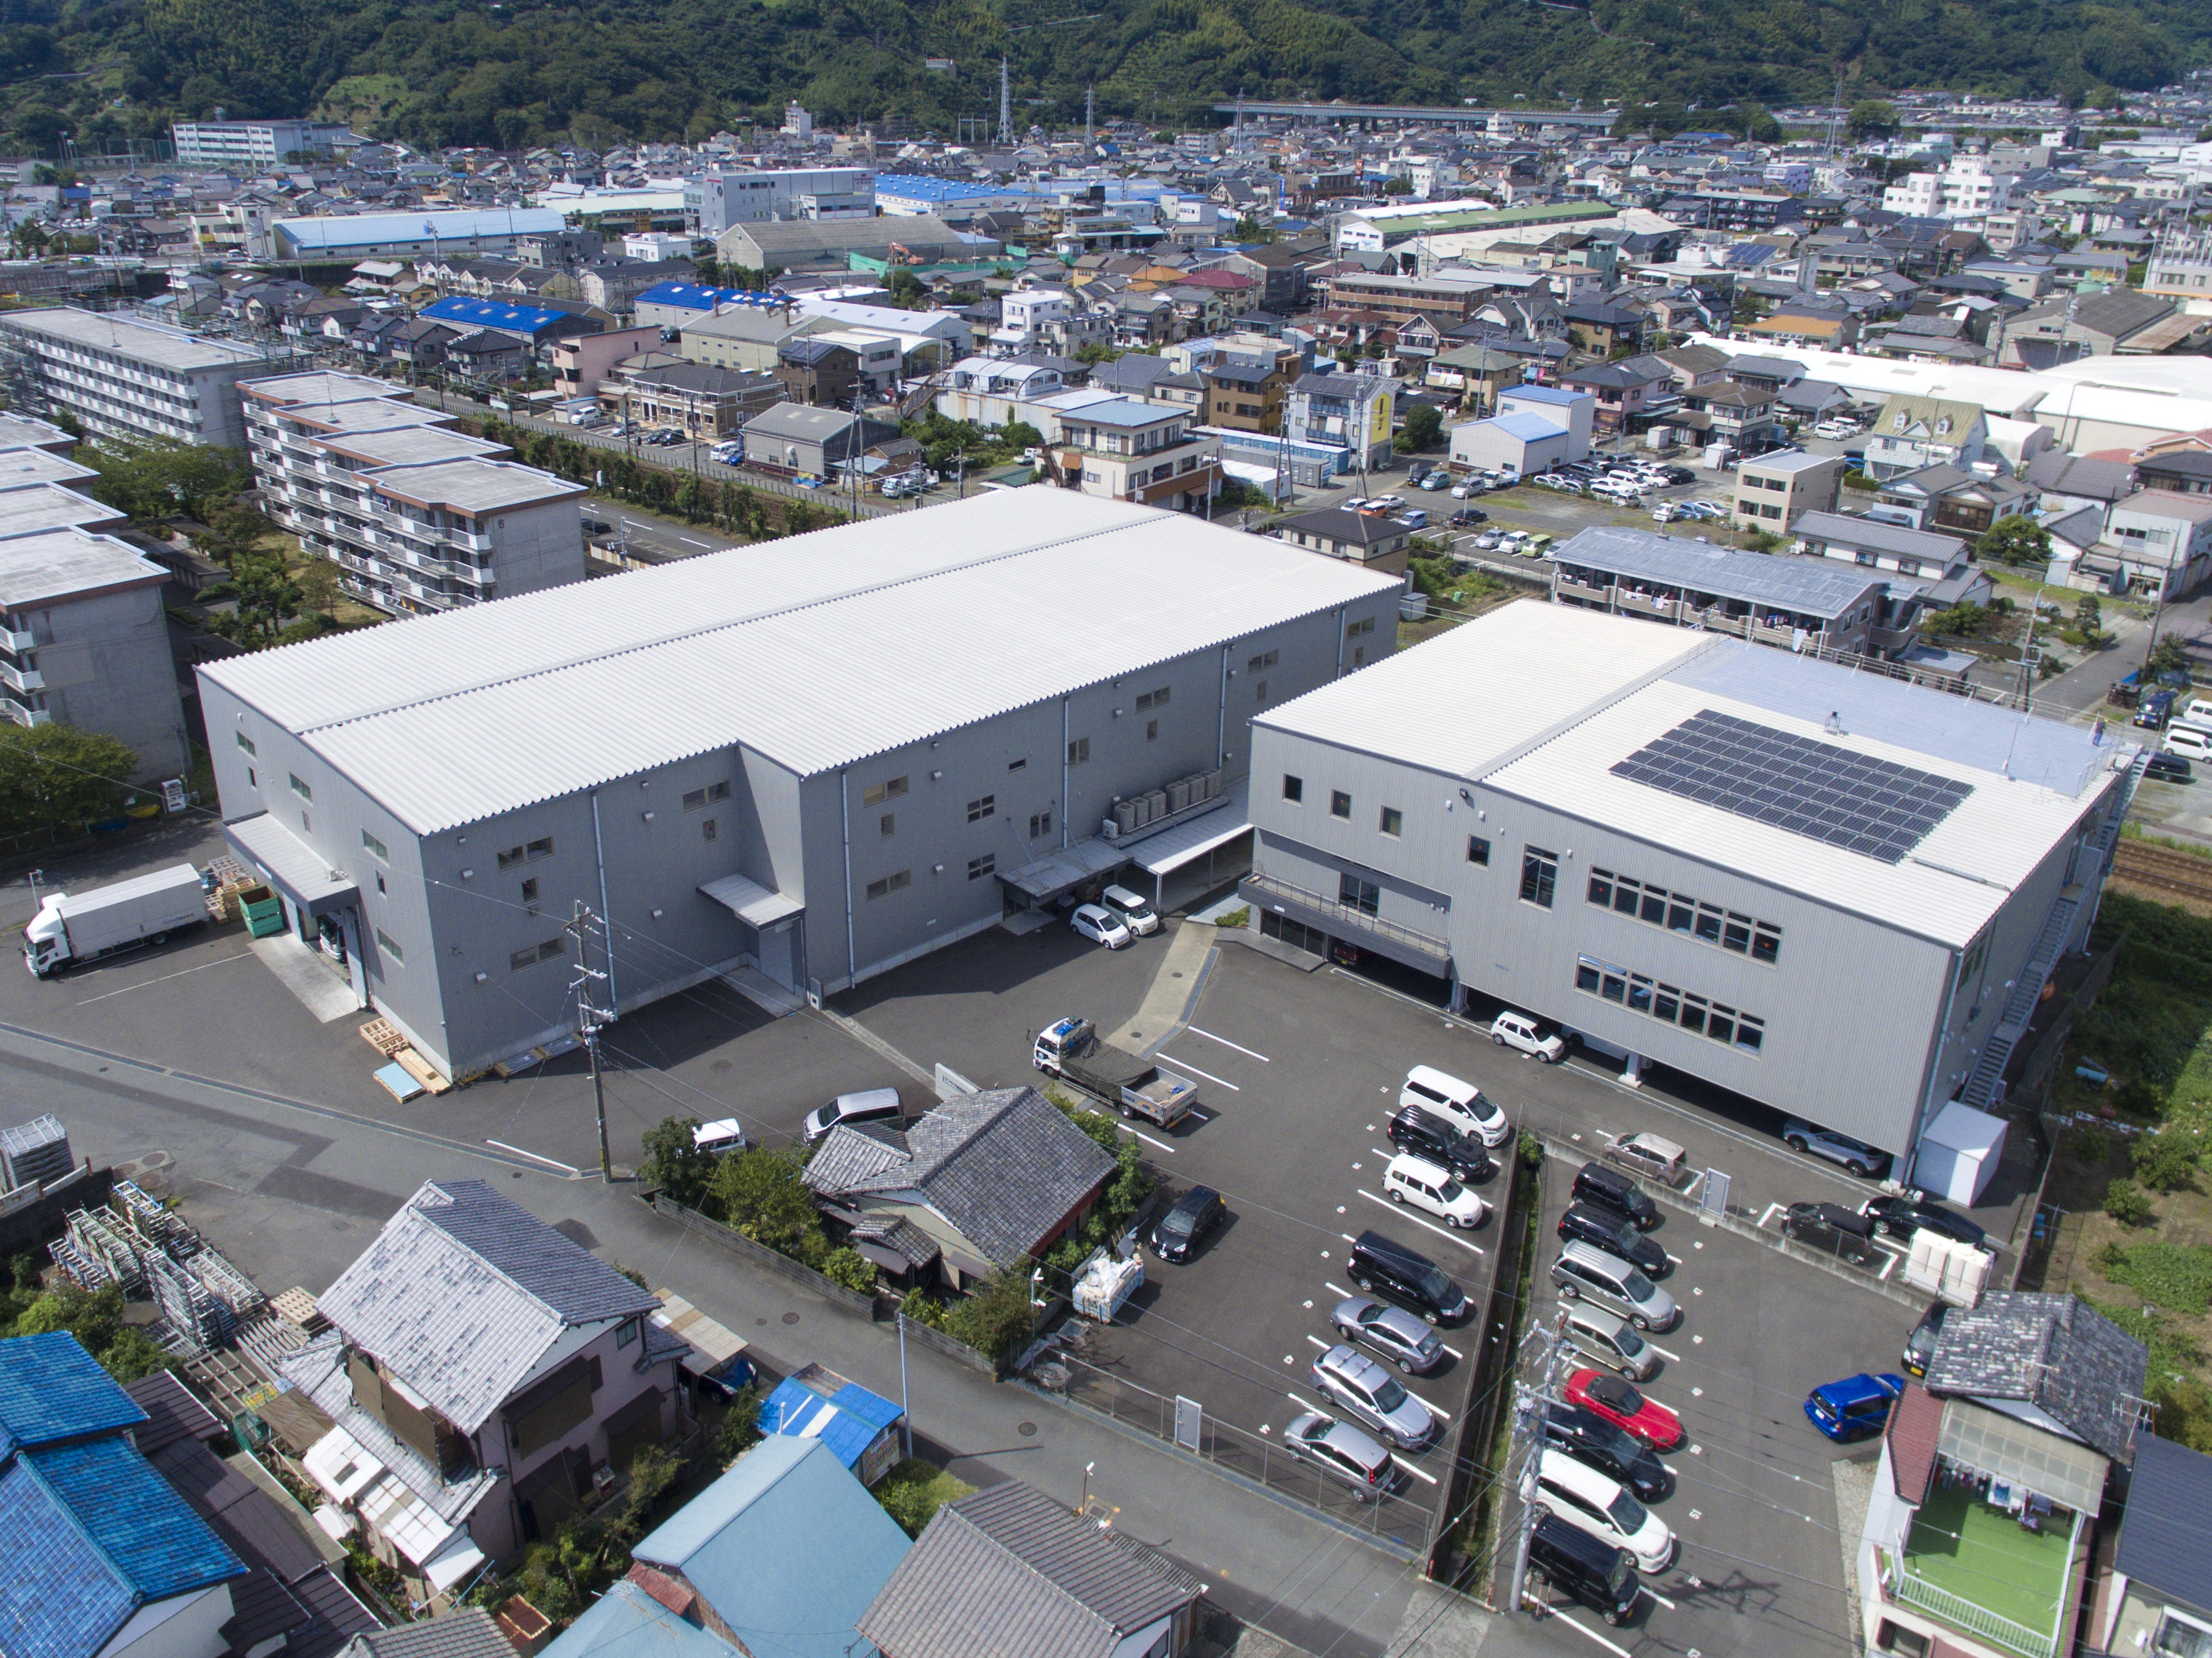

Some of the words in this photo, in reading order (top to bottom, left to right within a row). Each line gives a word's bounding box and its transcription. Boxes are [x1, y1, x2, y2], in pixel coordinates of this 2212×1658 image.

[498, 519, 505, 529] 6
[1690, 1445, 1701, 1454] 50
[1689, 1509, 1701, 1519] 51
